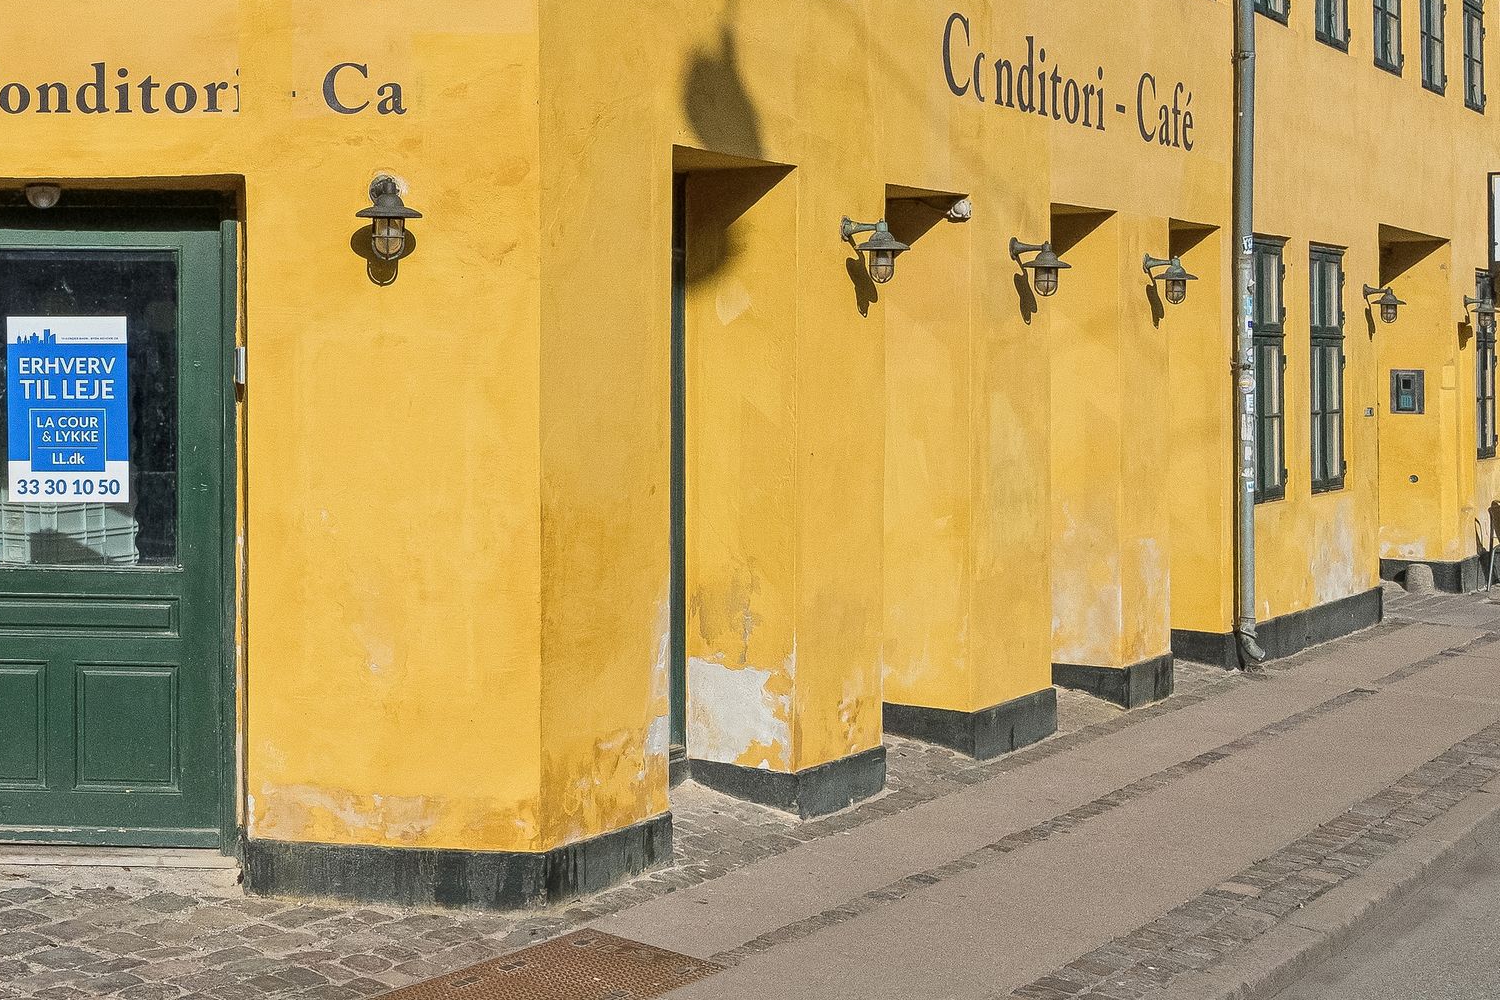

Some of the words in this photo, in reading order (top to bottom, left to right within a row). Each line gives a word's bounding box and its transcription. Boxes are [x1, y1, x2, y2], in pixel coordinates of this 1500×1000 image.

[1136, 72, 1195, 152] Café
[18, 357, 116, 374] ERHVERV
[19, 379, 57, 400] TIL
[62, 379, 115, 400] LEJE
[36, 416, 55, 428] LA
[58, 416, 99, 428] COUR
[41, 430, 52, 443] &
[55, 430, 99, 442] LYKKE
[52, 452, 85, 465] LL.dk
[17, 479, 40, 495] 33
[44, 479, 68, 495] 30
[72, 479, 94, 495] 10
[97, 479, 121, 496] 50
